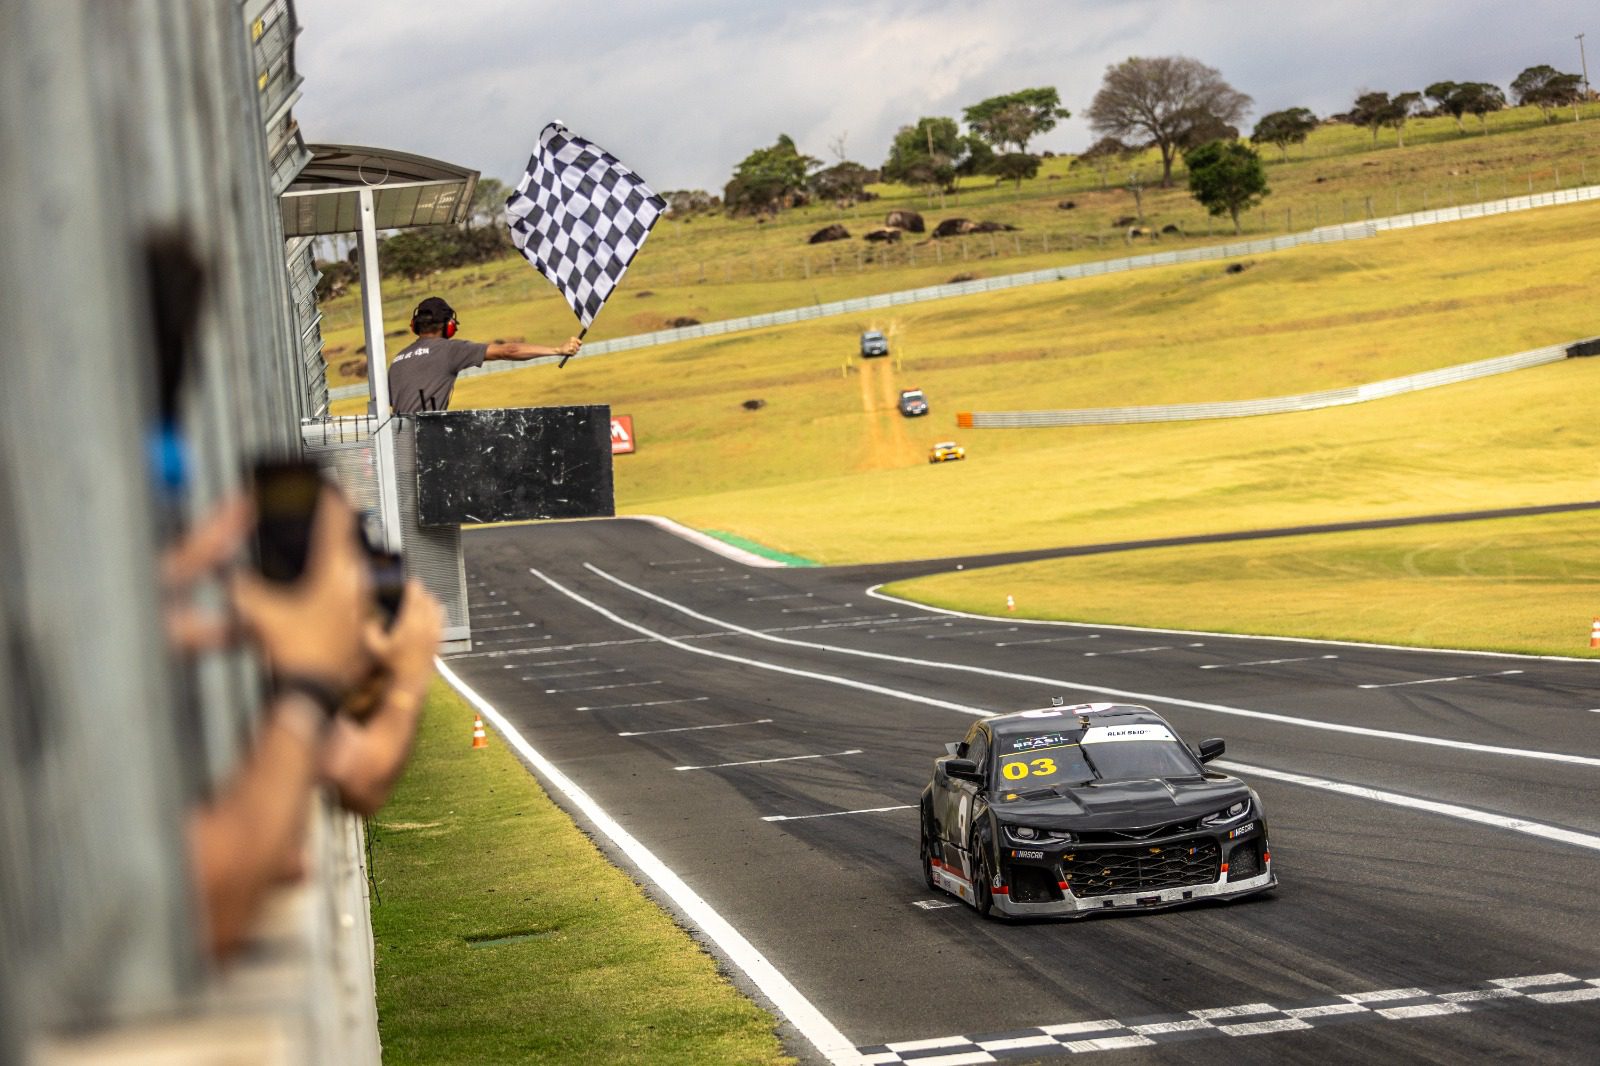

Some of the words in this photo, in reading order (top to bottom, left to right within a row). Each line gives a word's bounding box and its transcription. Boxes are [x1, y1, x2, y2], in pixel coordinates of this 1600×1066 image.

[1013, 736, 1069, 749] BRASIL
[1002, 757, 1057, 780] 03
[1235, 822, 1254, 837] NASCAR
[1018, 850, 1044, 859] NASCAR
